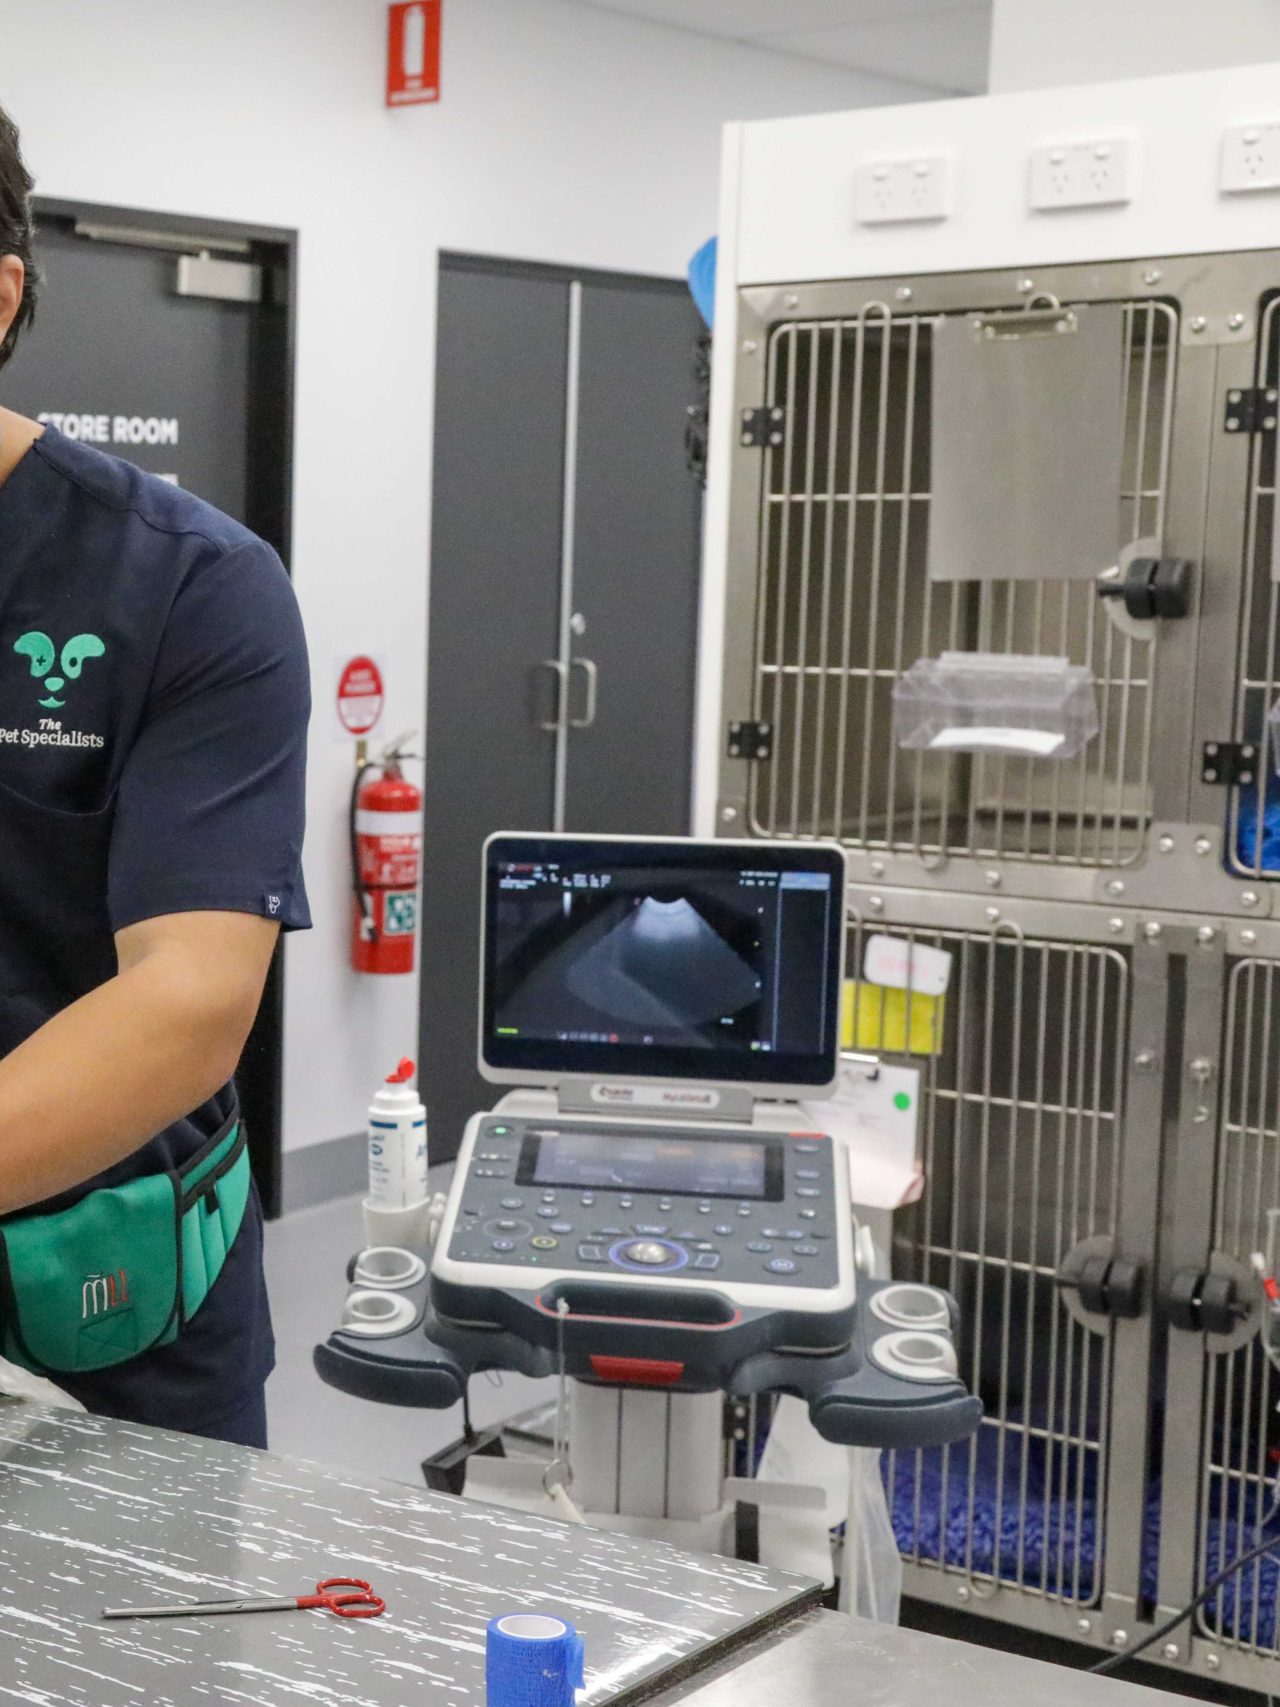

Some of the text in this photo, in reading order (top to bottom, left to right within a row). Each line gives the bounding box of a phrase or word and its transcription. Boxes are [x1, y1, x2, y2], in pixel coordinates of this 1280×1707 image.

[113, 416, 178, 445] ROOM
[39, 718, 62, 730] The
[21, 729, 105, 748] Specialists
